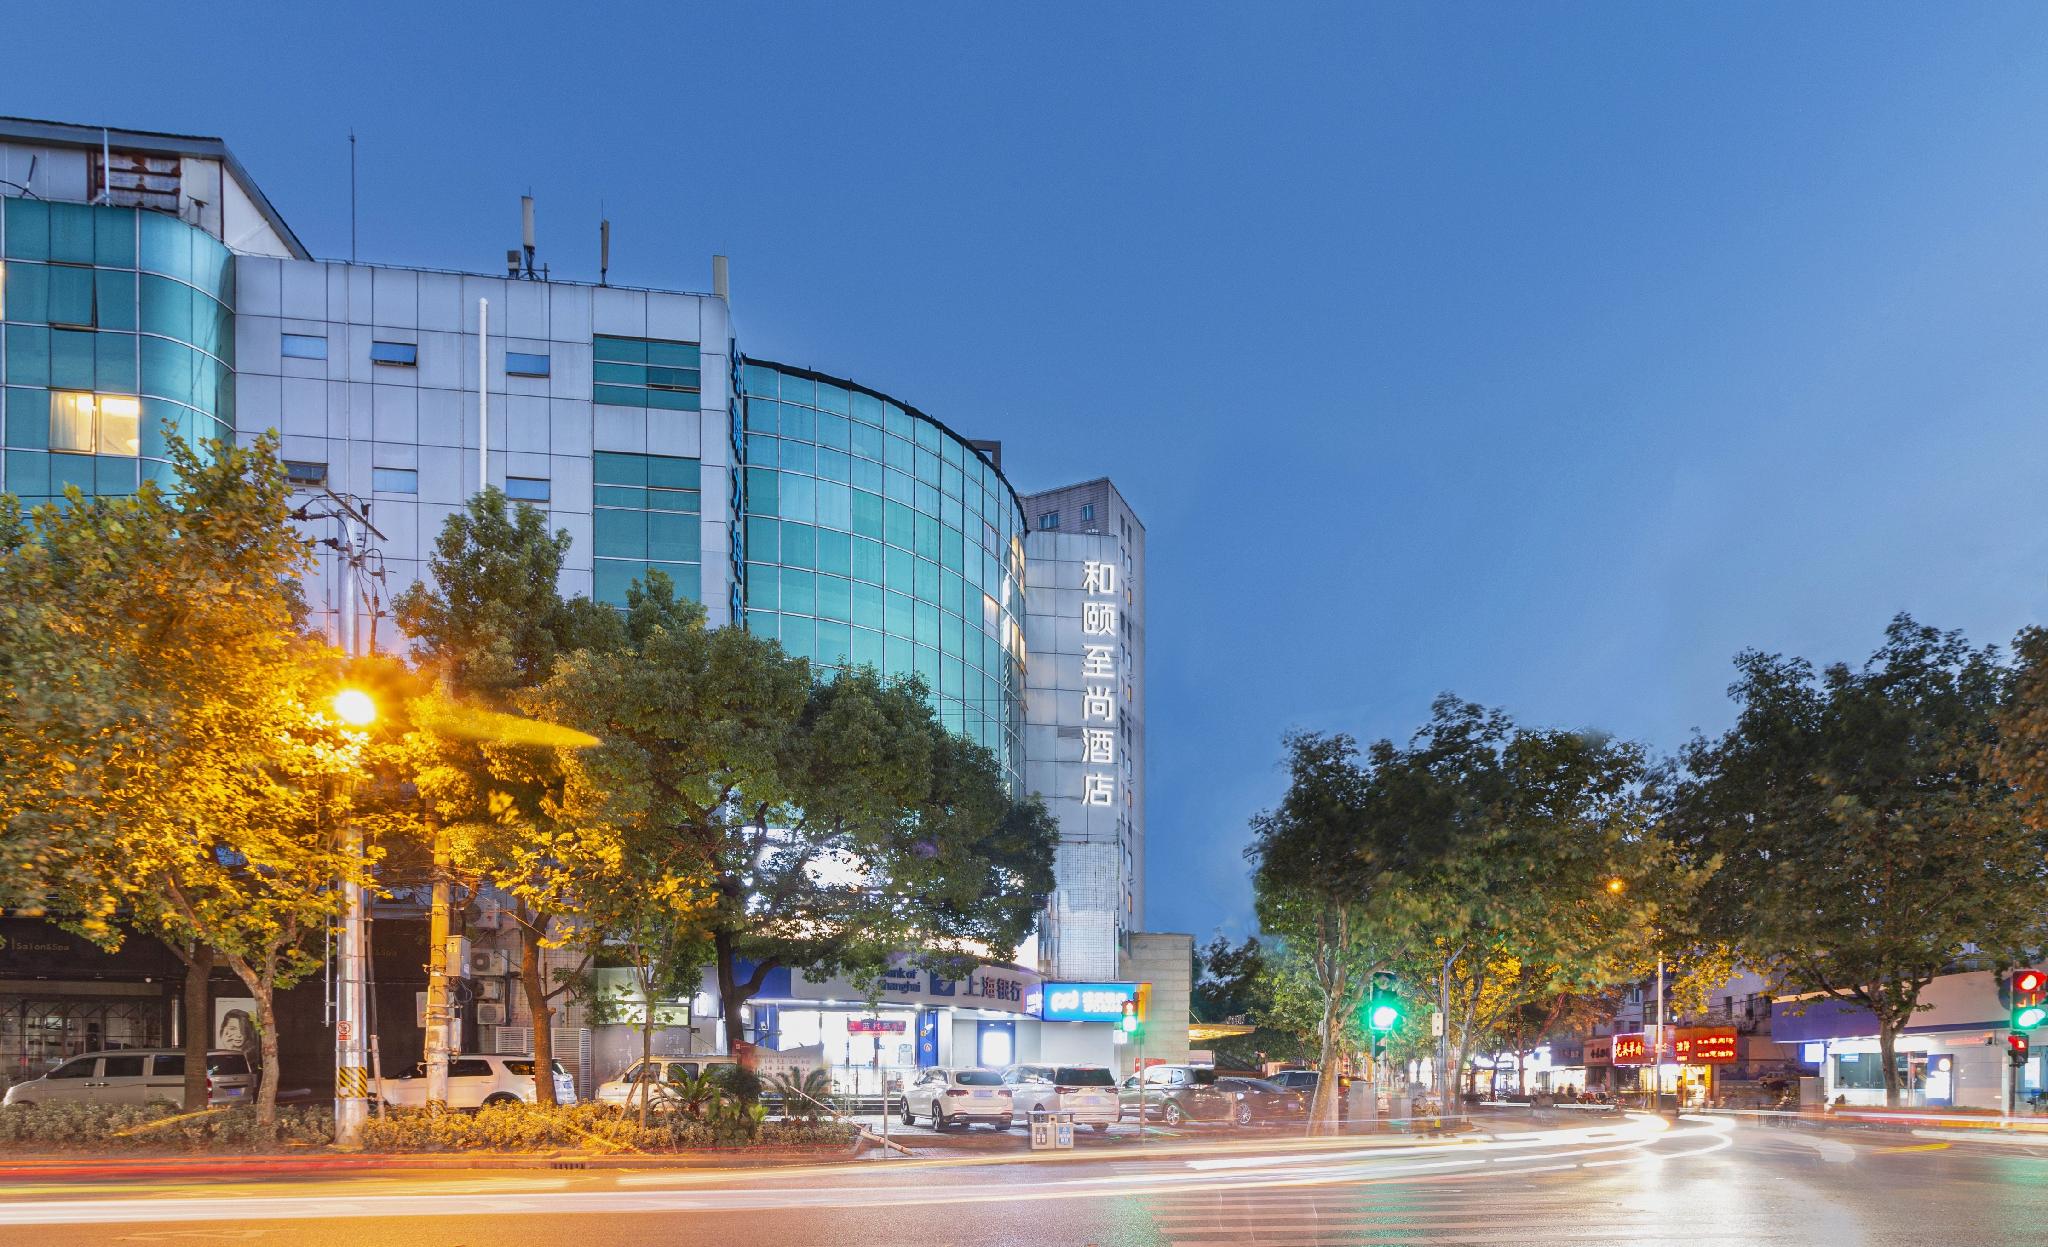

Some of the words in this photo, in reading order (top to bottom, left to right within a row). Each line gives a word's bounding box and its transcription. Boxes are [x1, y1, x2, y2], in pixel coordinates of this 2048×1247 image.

[1082, 560, 1116, 807] 和颐至尚酒店
[963, 975, 1023, 1002] 上海银行
